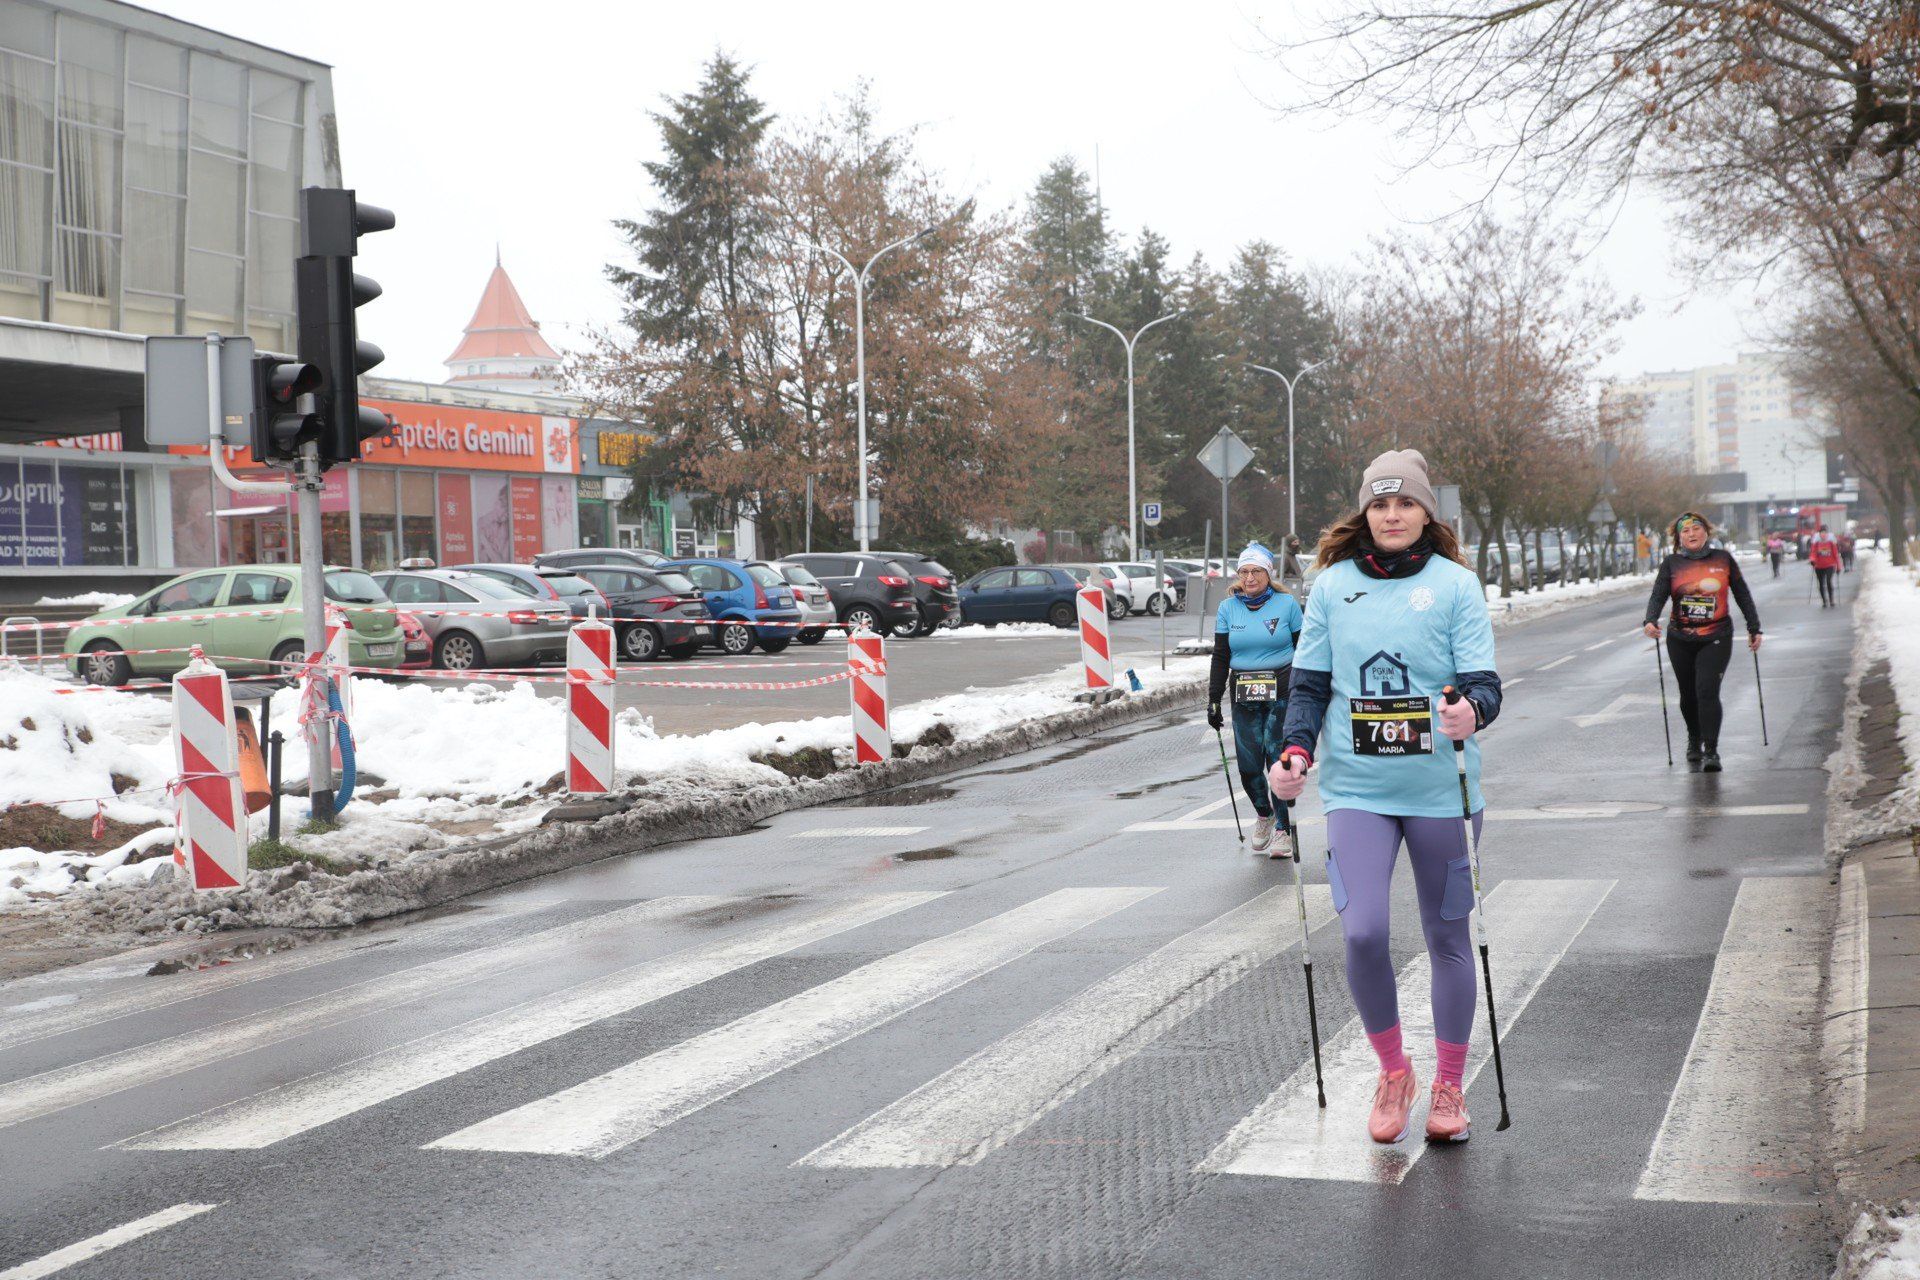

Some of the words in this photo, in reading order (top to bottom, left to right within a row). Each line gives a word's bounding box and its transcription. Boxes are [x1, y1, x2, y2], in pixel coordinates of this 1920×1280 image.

[464, 422, 535, 457] Gemini
[13, 483, 65, 505] OPTIC
[1148, 506, 1157, 517] P
[14, 545, 66, 558] JZIORE
[1688, 605, 1707, 615] 726
[1244, 684, 1267, 695] 738
[1367, 720, 1410, 743] 761
[1377, 745, 1406, 754] MARIA
